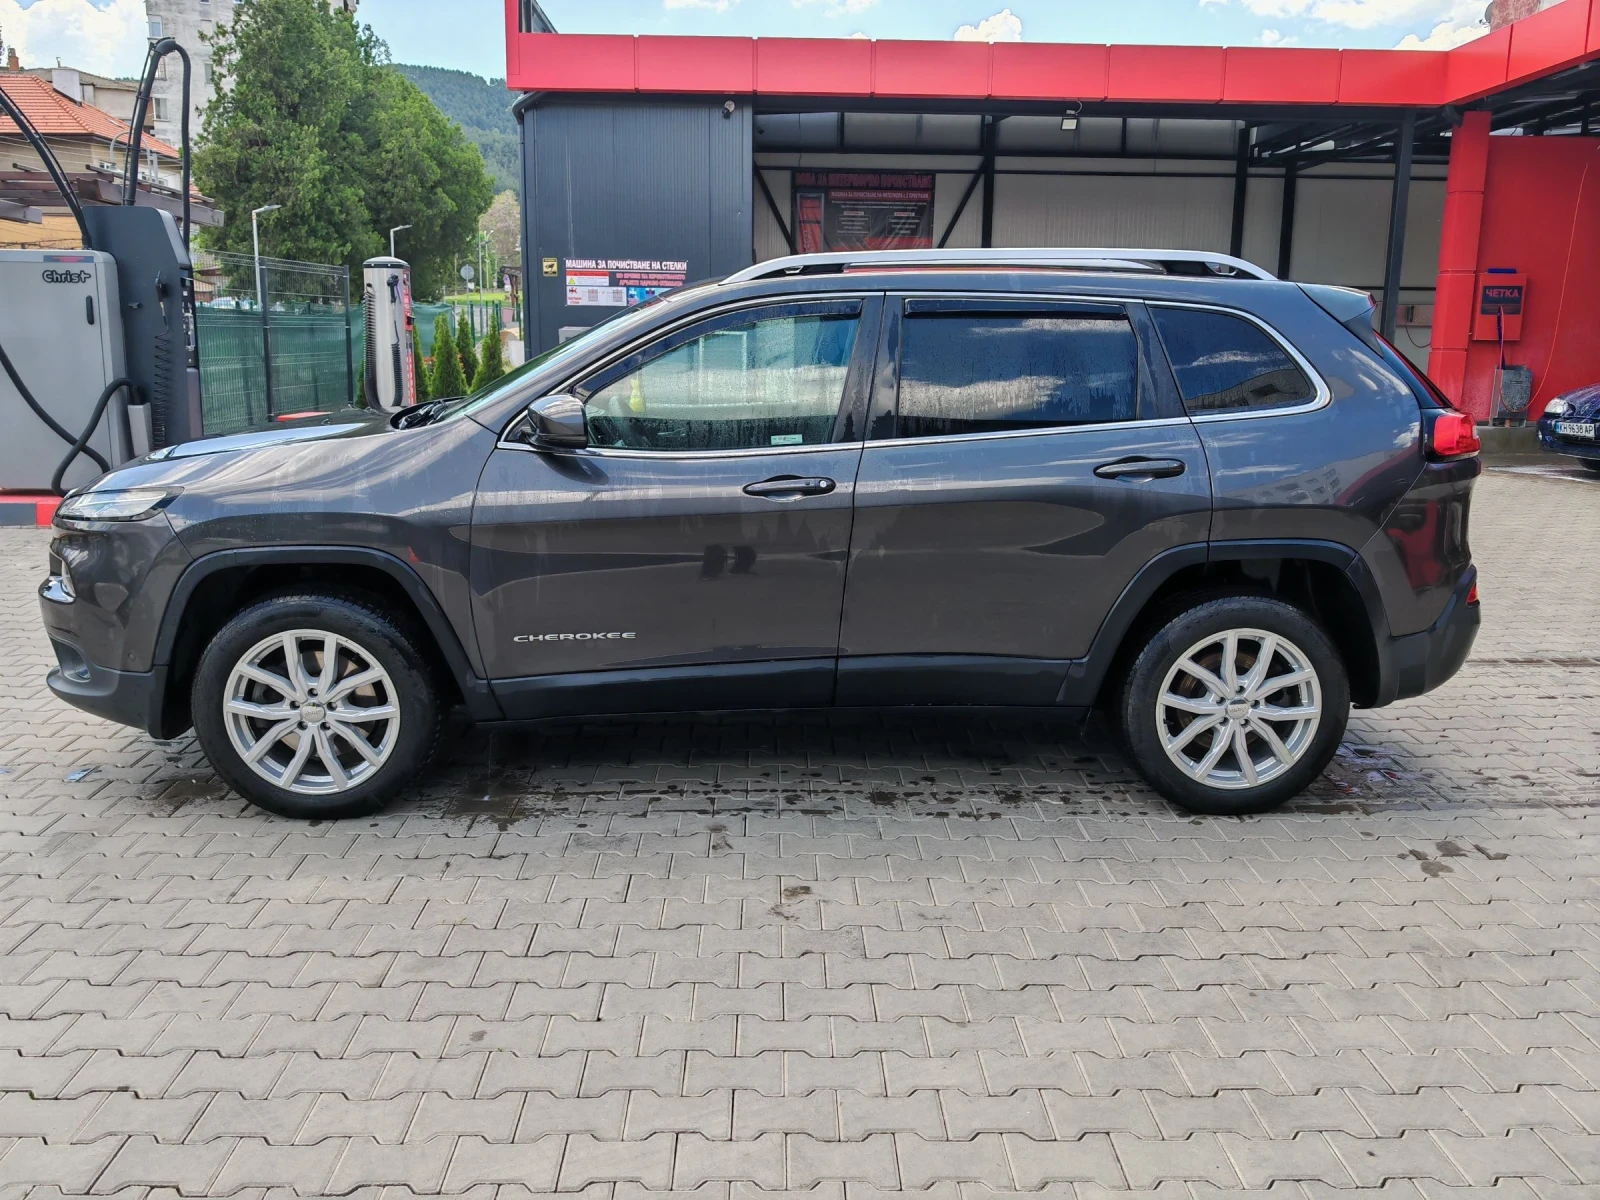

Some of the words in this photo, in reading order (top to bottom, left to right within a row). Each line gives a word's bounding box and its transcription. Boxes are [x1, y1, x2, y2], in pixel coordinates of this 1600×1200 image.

[565, 259, 597, 269] МАШИНА
[597, 260, 607, 269] ЗА
[607, 260, 651, 270] ПОЧИСТВАНЕ
[651, 260, 661, 270] НА
[661, 261, 687, 271] СТЕЛКИ
[42, 269, 92, 283] Christ
[1485, 288, 1519, 298] ЧЕТКА
[513, 632, 637, 643] CHEROKEE
